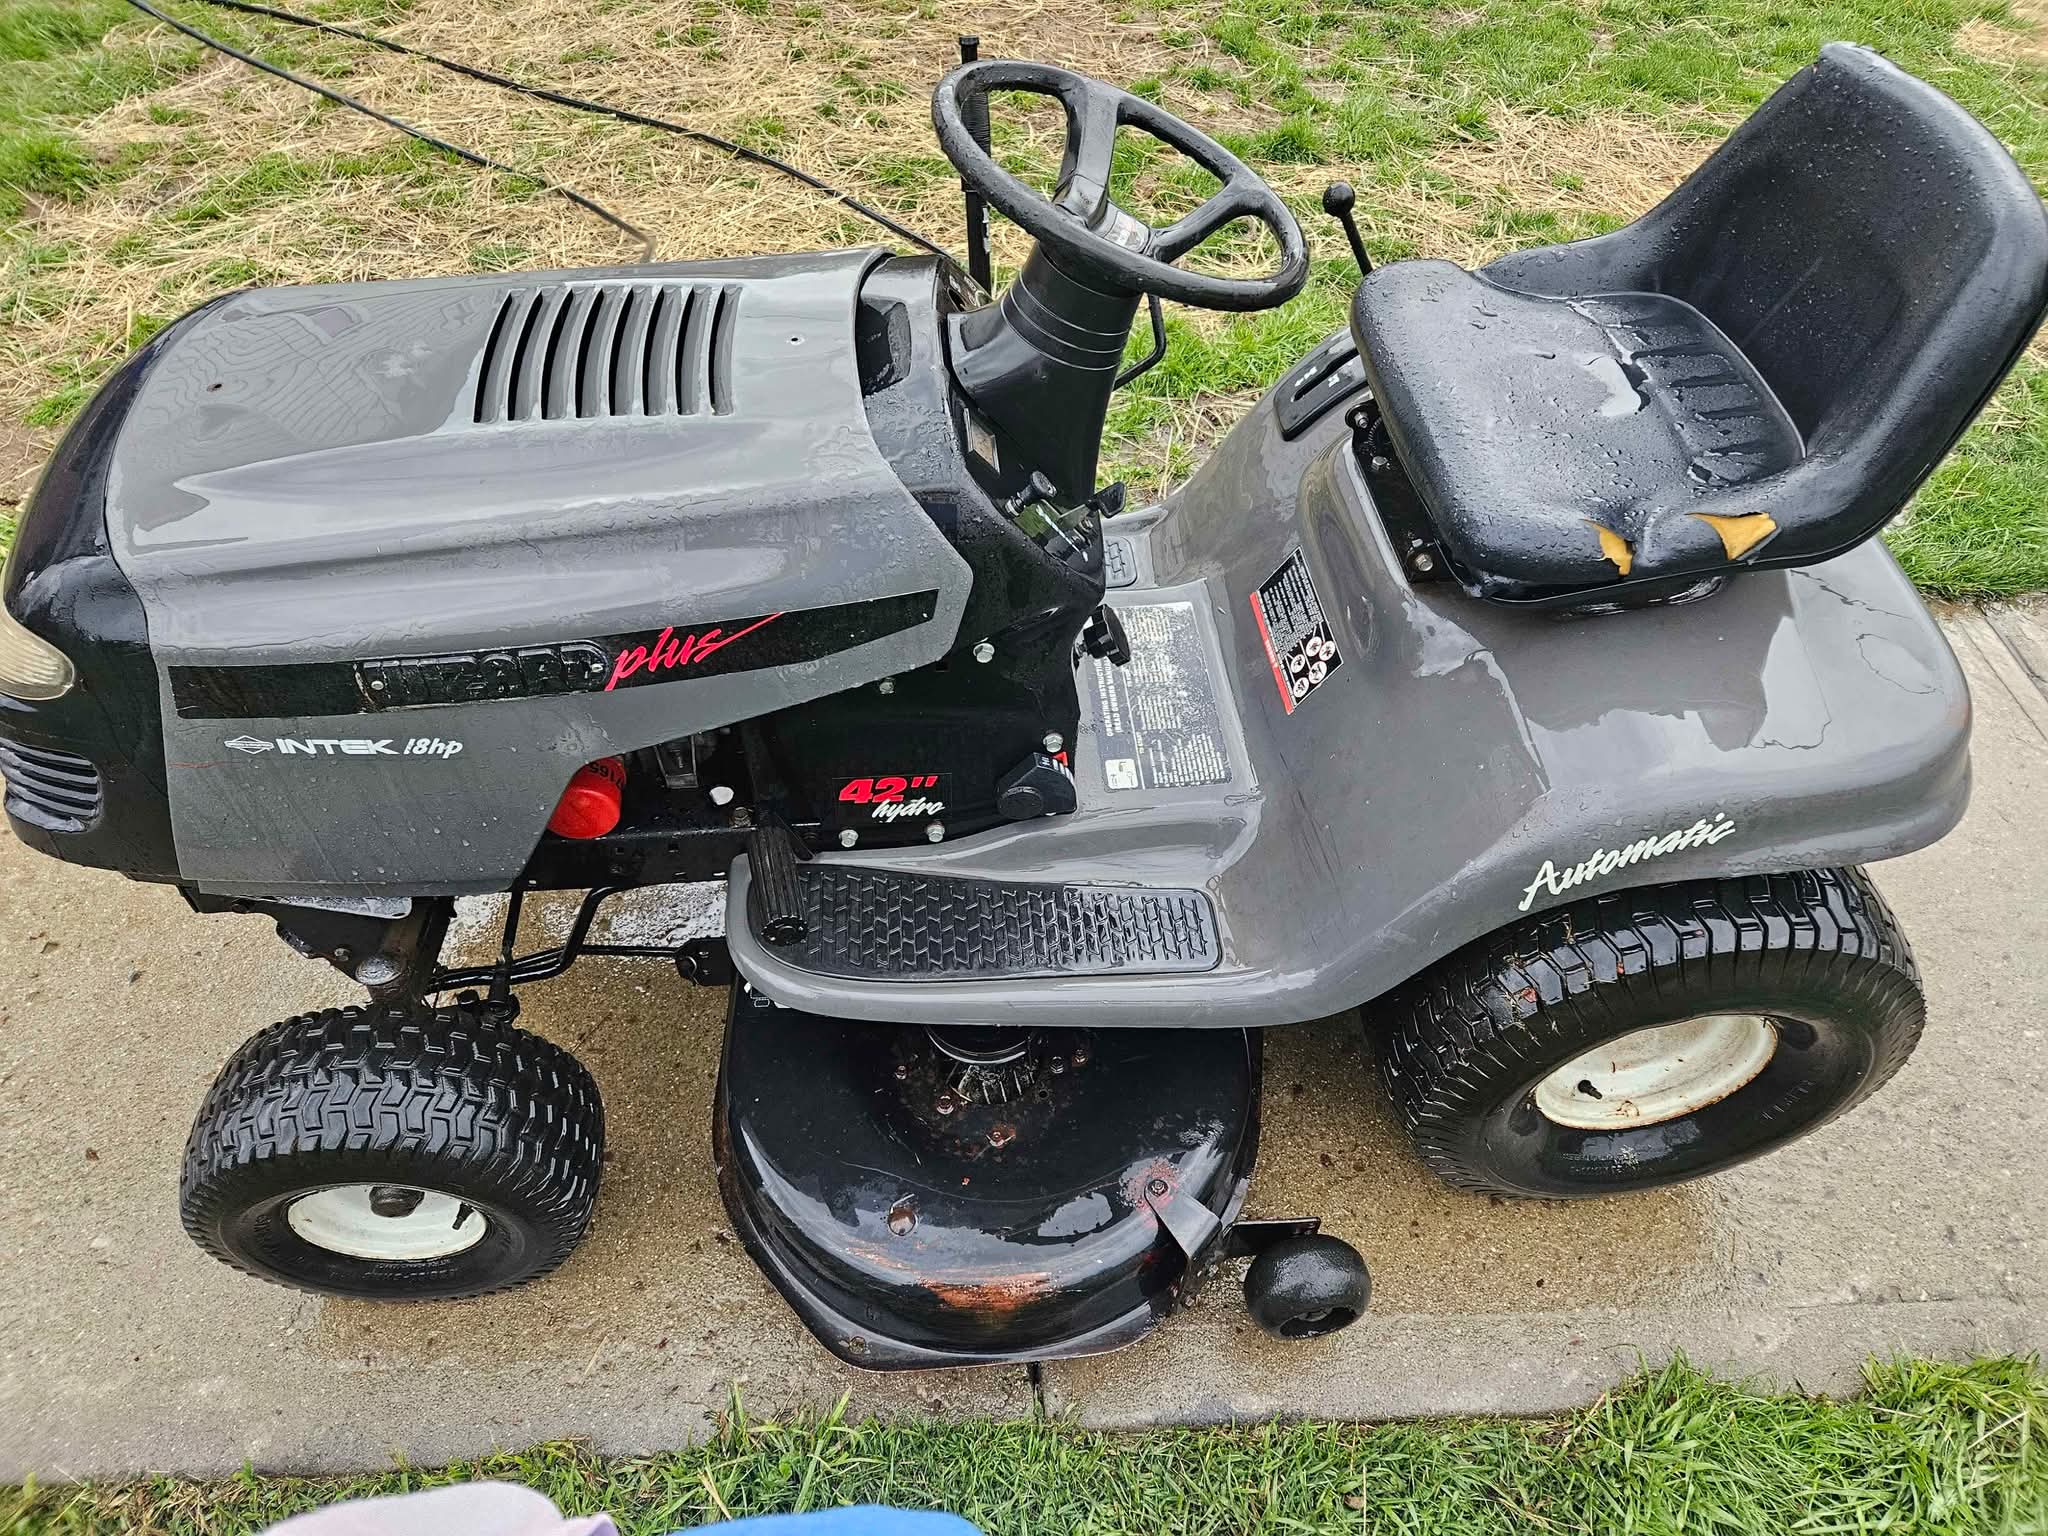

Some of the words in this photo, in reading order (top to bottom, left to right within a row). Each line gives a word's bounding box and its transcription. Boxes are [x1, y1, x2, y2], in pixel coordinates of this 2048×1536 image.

[604, 616, 768, 692] plus
[275, 737, 400, 756] INTEK
[402, 736, 463, 759] 18hp
[838, 775, 939, 805] 42"
[871, 796, 946, 824] hydro
[1518, 812, 1736, 912] Automatic
